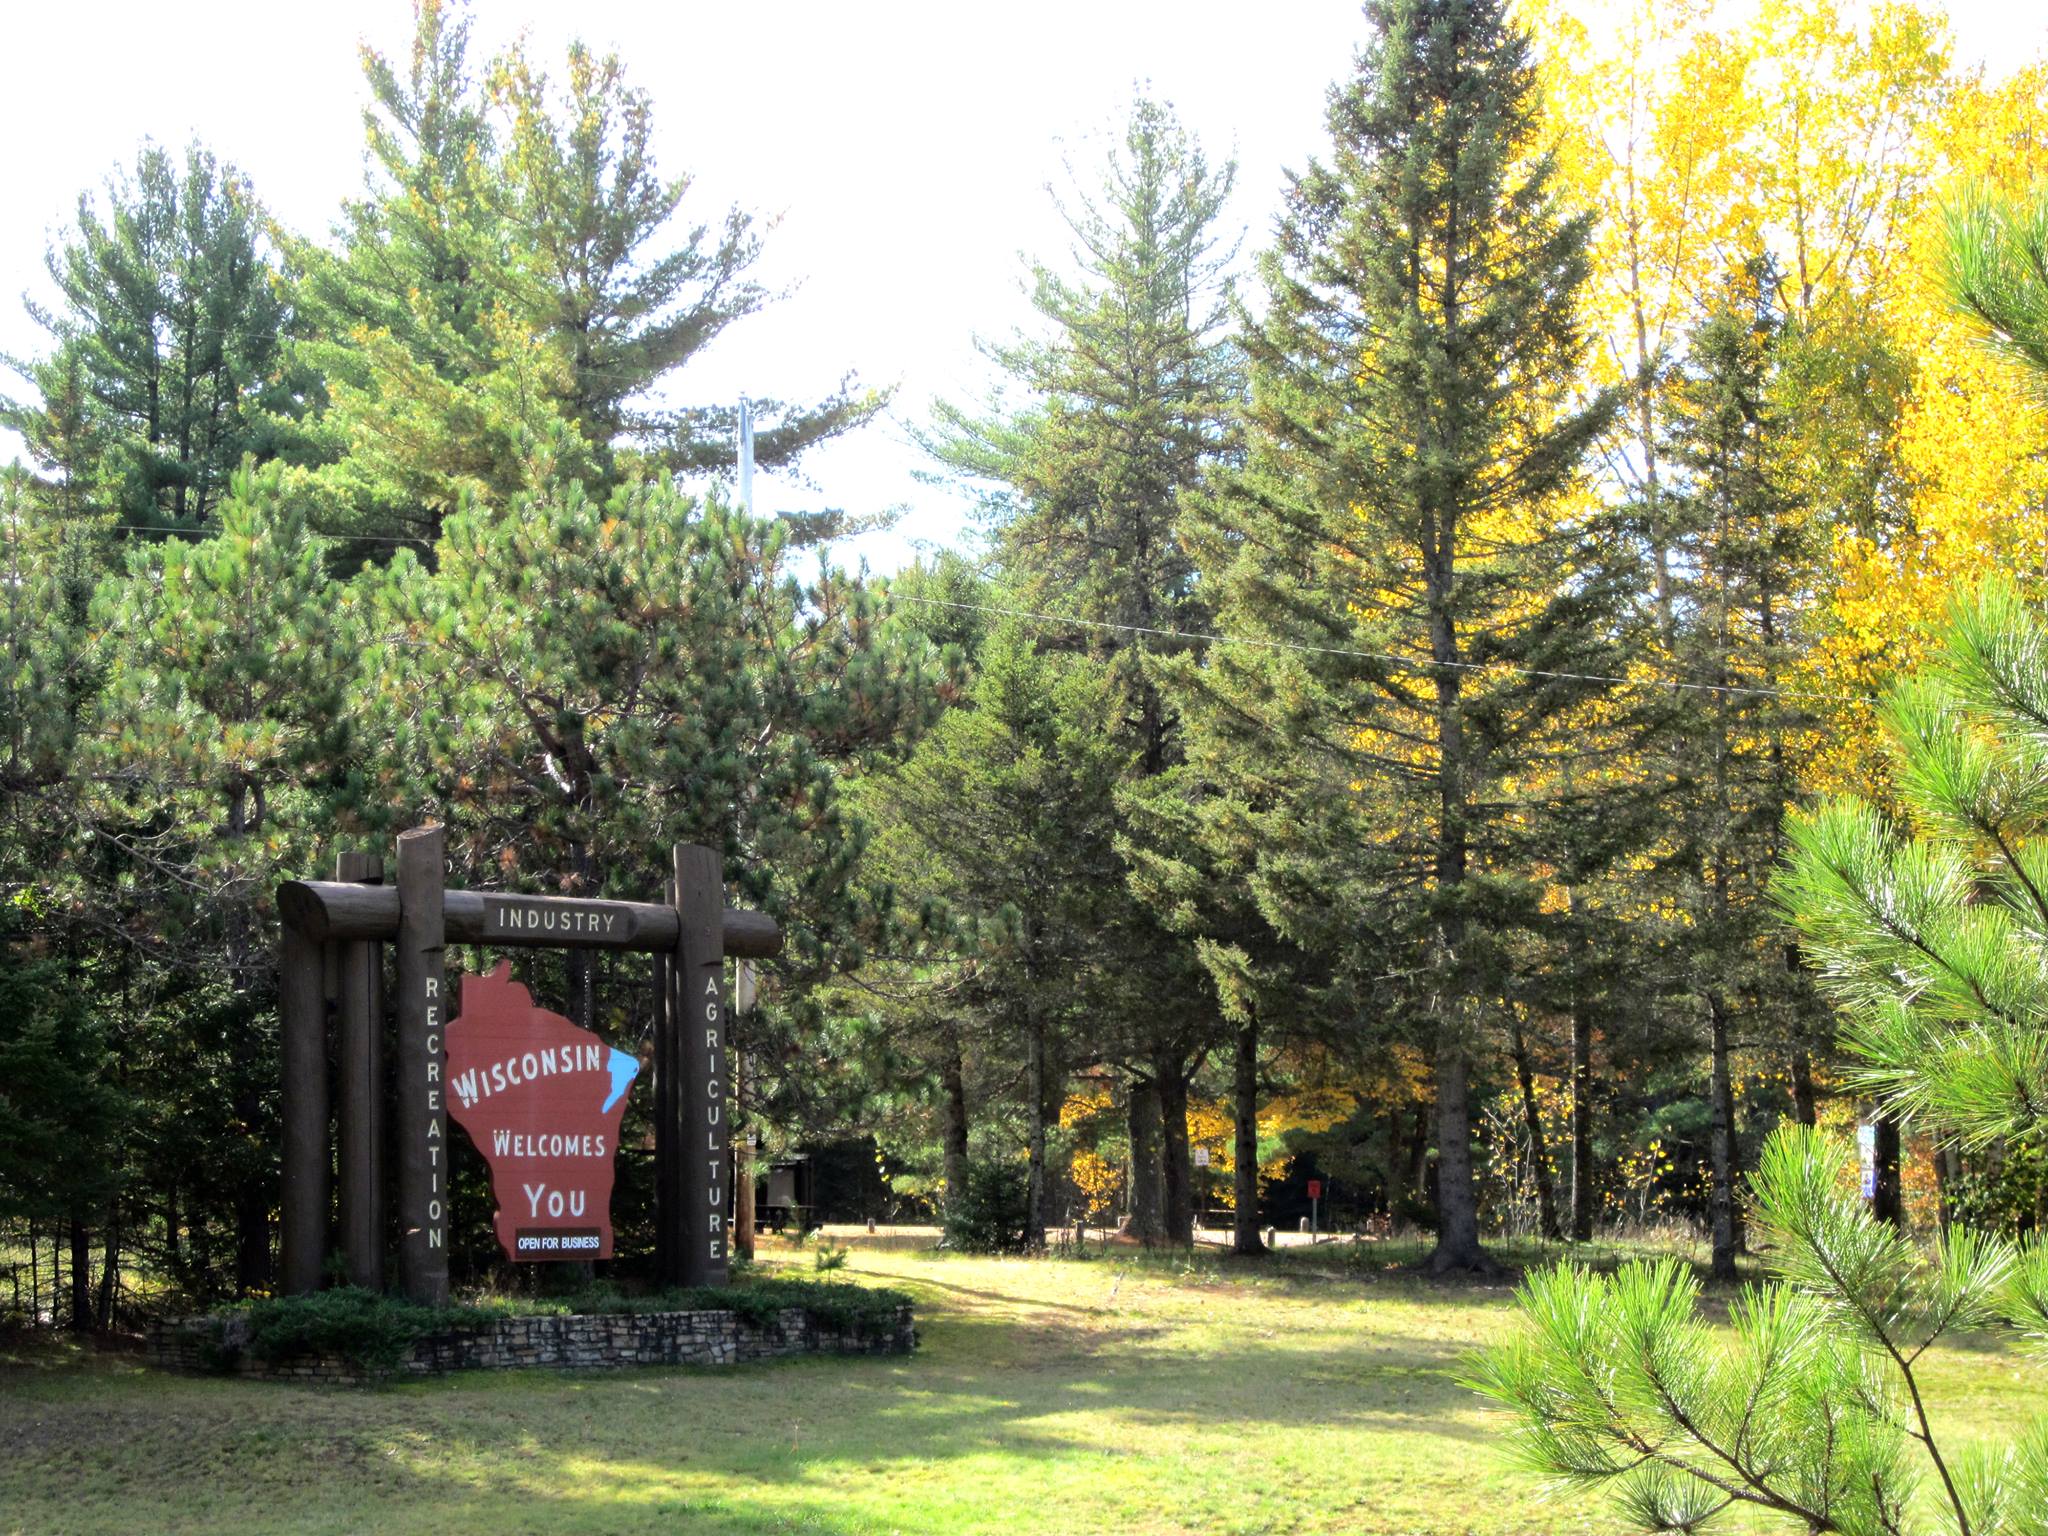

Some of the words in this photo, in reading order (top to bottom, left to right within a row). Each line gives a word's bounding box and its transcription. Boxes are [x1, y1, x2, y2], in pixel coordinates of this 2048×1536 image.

[499, 908, 614, 932] INDUSTRY
[451, 1044, 601, 1109] WISCONSIN
[425, 976, 441, 1248] RECREATION
[705, 976, 721, 1259] AGRICULTURE
[493, 1129, 605, 1157] WELCOMES
[523, 1183, 585, 1218] YOU
[518, 1237, 540, 1250] OPEN
[542, 1237, 559, 1249] FOR
[561, 1236, 600, 1249] BUSINESS
